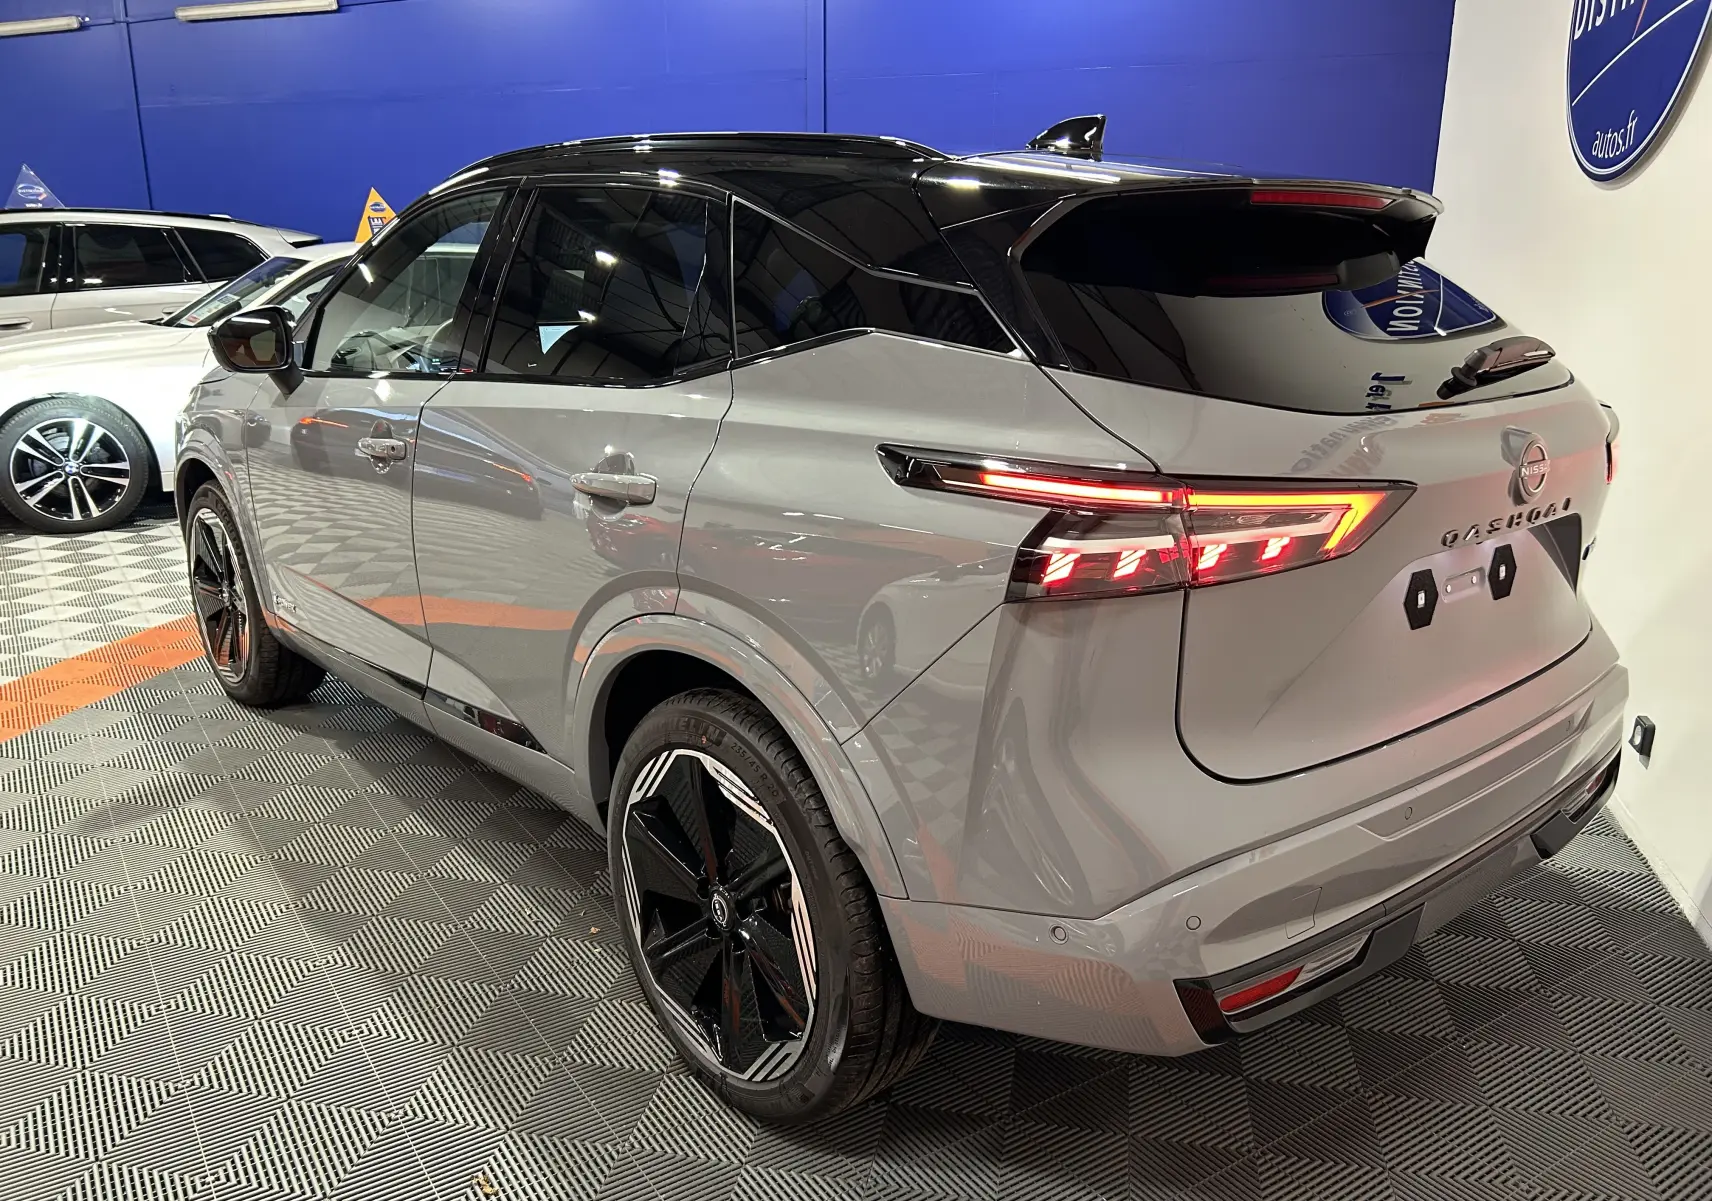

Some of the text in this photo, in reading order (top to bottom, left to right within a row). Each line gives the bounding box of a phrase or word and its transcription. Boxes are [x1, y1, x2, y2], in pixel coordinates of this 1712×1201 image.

[1592, 110, 1638, 158] autos.fr
[1521, 463, 1550, 477] NISS
[1441, 497, 1572, 547] QASHQAI
